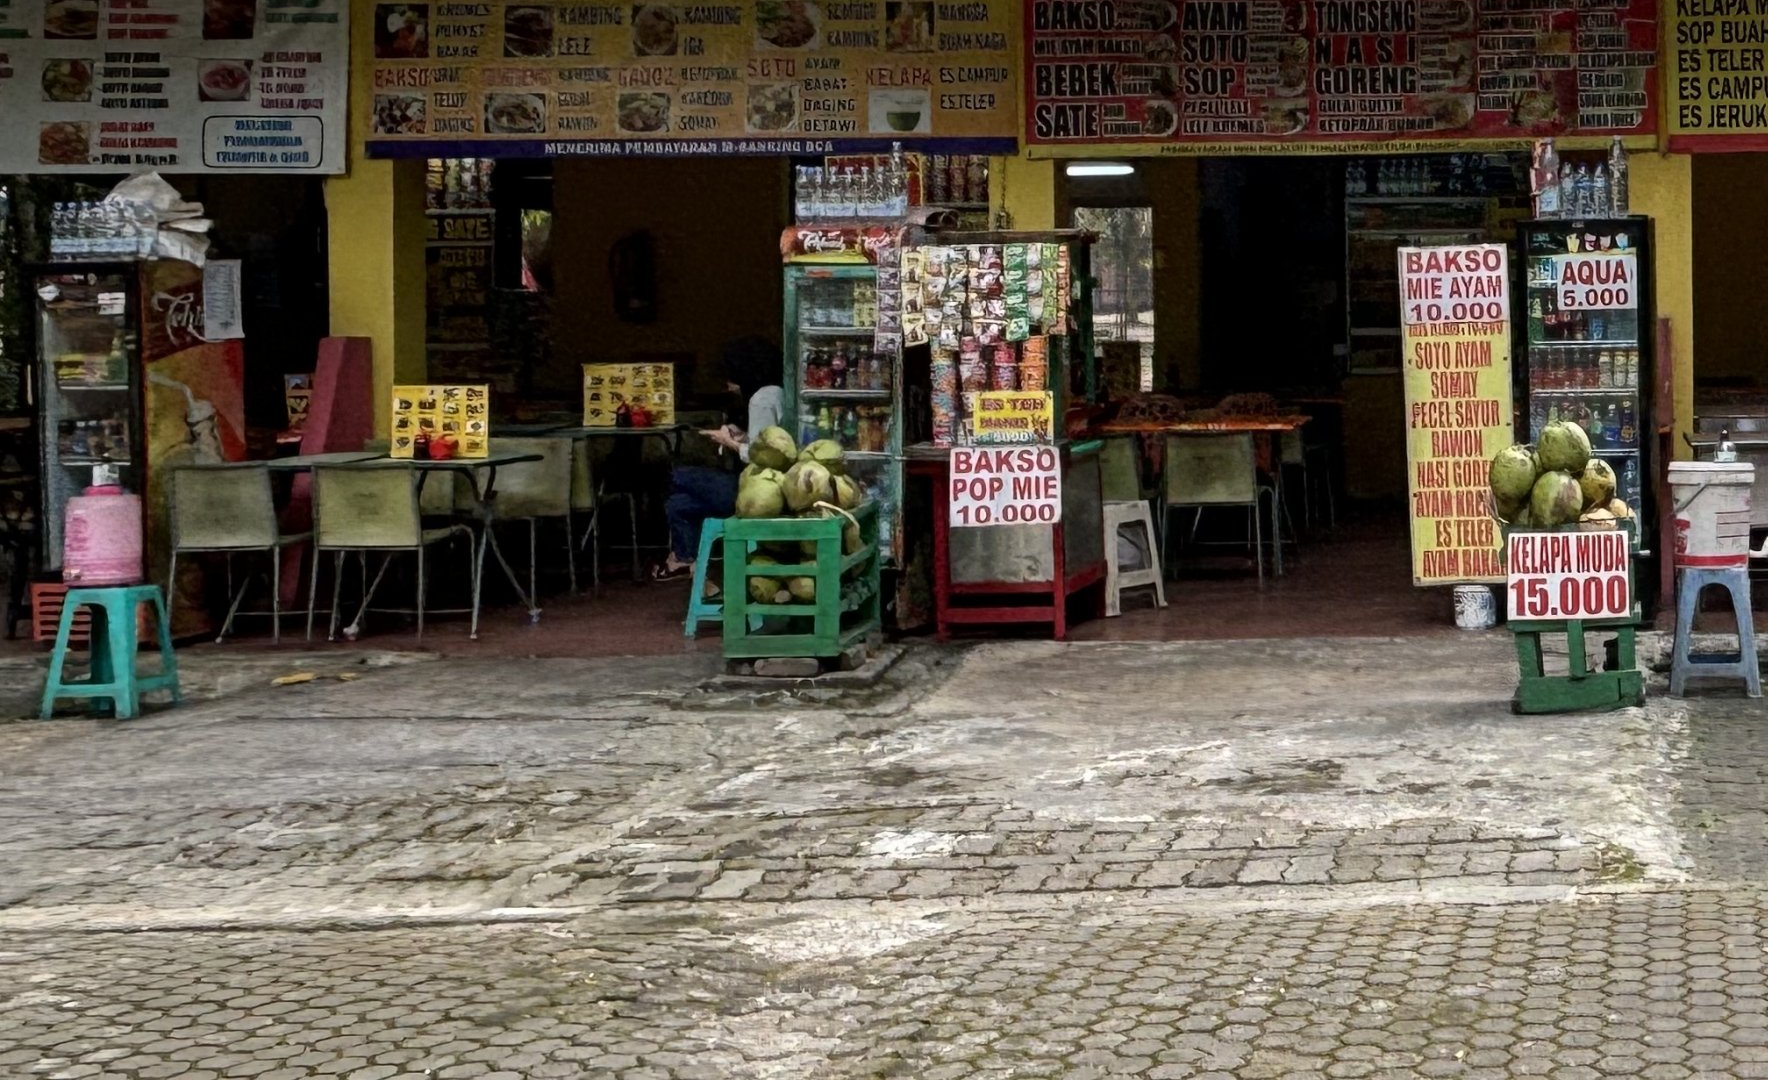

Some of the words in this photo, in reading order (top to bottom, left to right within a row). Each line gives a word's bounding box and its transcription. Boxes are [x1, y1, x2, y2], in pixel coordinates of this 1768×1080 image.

[1035, 0, 1116, 31] BAKSO
[1182, 1, 1248, 31] AYAM
[1314, 0, 1417, 32] TONGSENG
[1677, 22, 1714, 44] SOP
[1182, 34, 1249, 64] SOTO
[1678, 51, 1700, 73] ES
[1708, 50, 1765, 71] TELER
[748, 58, 796, 77] SOTO
[866, 68, 933, 86] KELAPA
[1035, 64, 1118, 97] BEBEK
[1315, 66, 1418, 94] GORENG
[1183, 66, 1237, 96] SOP
[1679, 78, 1700, 100] ES
[804, 98, 855, 111] DAGING
[1679, 106, 1701, 128] ES
[1708, 104, 1768, 127] JERUK
[804, 119, 856, 132] BETAWI
[1035, 102, 1099, 138] SATE
[1406, 249, 1501, 274] BAKSO
[1562, 260, 1628, 285] AQUA
[1408, 278, 1443, 299] MIE
[1450, 276, 1502, 299] AYAM
[1563, 288, 1629, 307] 5.000
[1411, 302, 1503, 321] 10.000
[1455, 341, 1492, 368] AYAM
[1431, 371, 1478, 398] SOMAY
[1455, 400, 1500, 428] SAYUR
[955, 448, 1056, 473] BAKSO
[1417, 461, 1449, 488] NASI
[953, 477, 1003, 501] POP
[1012, 476, 1057, 500] MIE
[956, 504, 1055, 524] 10.000
[1436, 521, 1451, 547] ES
[1454, 520, 1493, 546] TELER
[1423, 550, 1459, 577] AYAM
[1511, 535, 1570, 573] KELAPA
[1576, 534, 1625, 572] MUDA
[1510, 575, 1627, 617] 15.000
